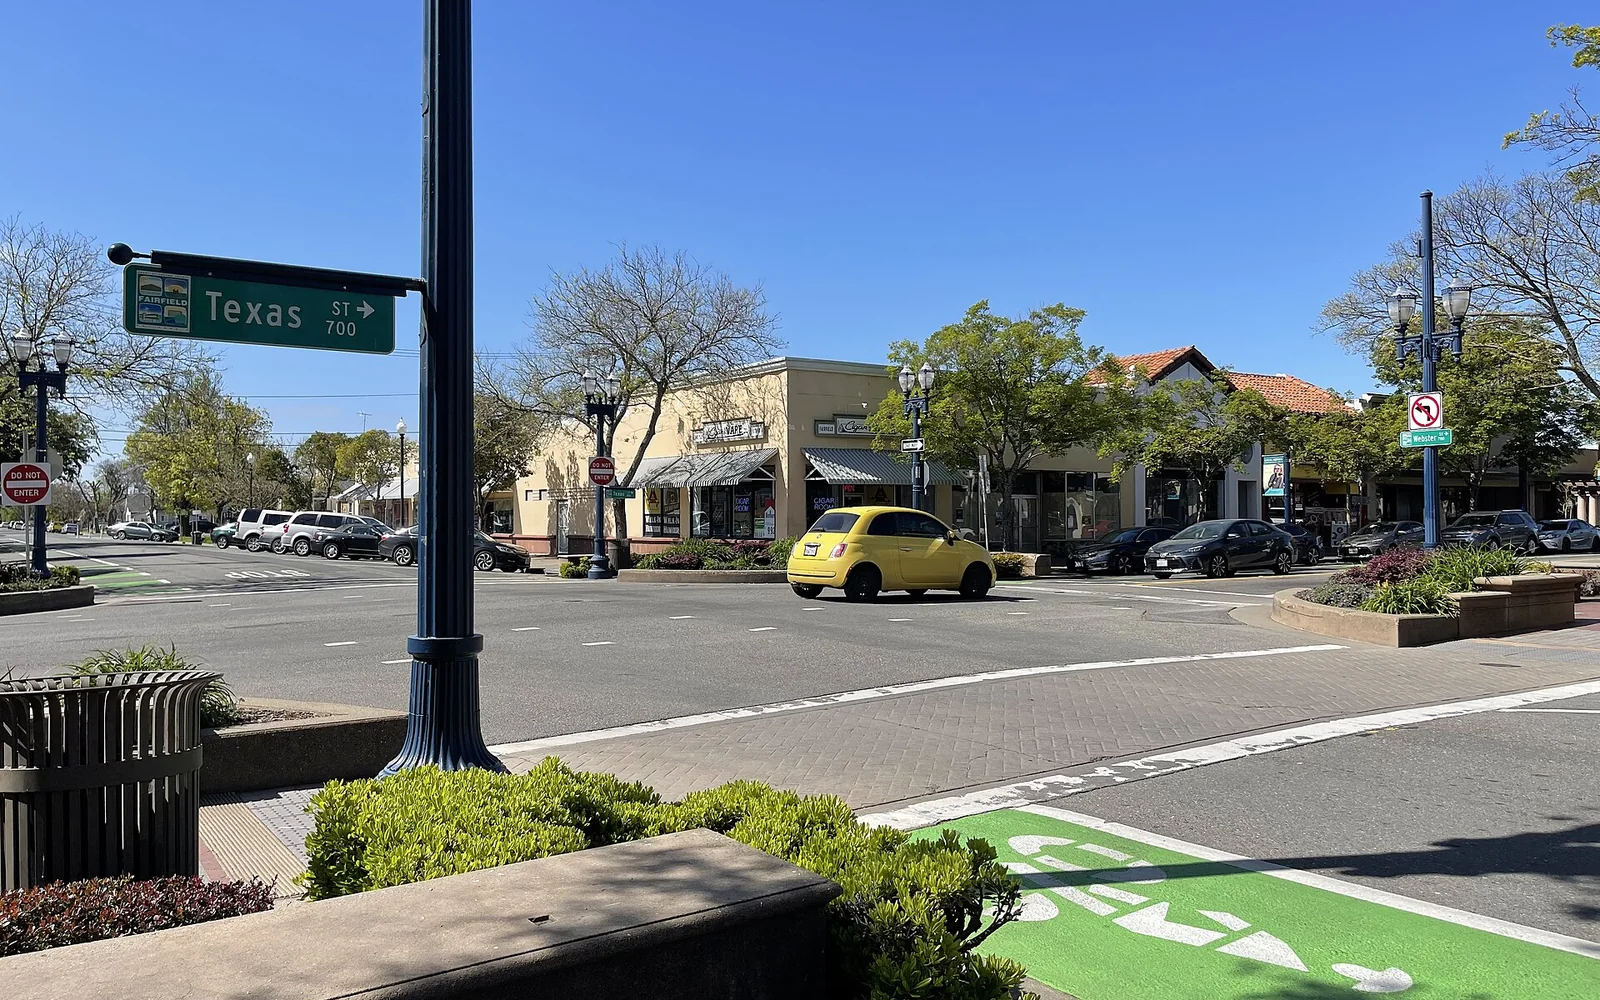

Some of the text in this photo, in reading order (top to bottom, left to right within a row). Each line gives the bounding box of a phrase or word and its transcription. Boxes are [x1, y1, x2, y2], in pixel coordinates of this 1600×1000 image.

[138, 295, 188, 306] FAIRFIELD
[205, 290, 350, 329] Texas ST
[325, 320, 356, 337] 700
[725, 424, 743, 435] VAPE
[1413, 435, 1437, 443] Webster
[13, 489, 39, 497] ENTER
[224, 569, 311, 578] STOP
